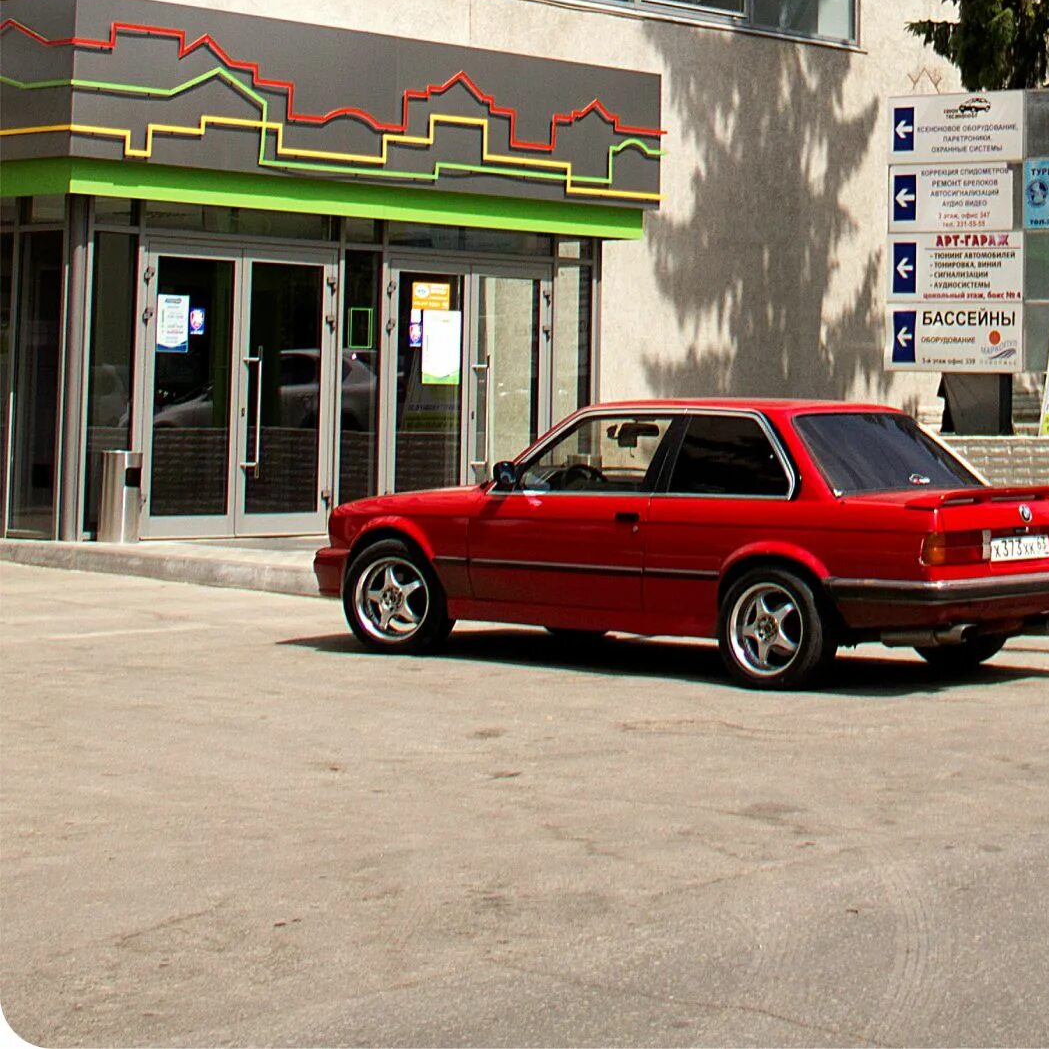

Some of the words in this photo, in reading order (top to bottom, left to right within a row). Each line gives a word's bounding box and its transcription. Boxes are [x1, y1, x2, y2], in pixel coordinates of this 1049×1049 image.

[960, 167, 1009, 176] СПИДОМЕТРОВ
[931, 179, 961, 188] РЕМОНТ
[963, 179, 998, 187] БРЕЛОКОВ
[942, 200, 964, 208] АУДИО
[965, 199, 988, 207] ВИДЕО
[936, 234, 1009, 247] АРТ-ГАРАЖ
[964, 251, 1015, 259] АВТОМОБИЛЕЙ
[922, 307, 1015, 327] БАССЕЙНЫ
[921, 336, 976, 344] ОБОРУДОВАНИЕ
